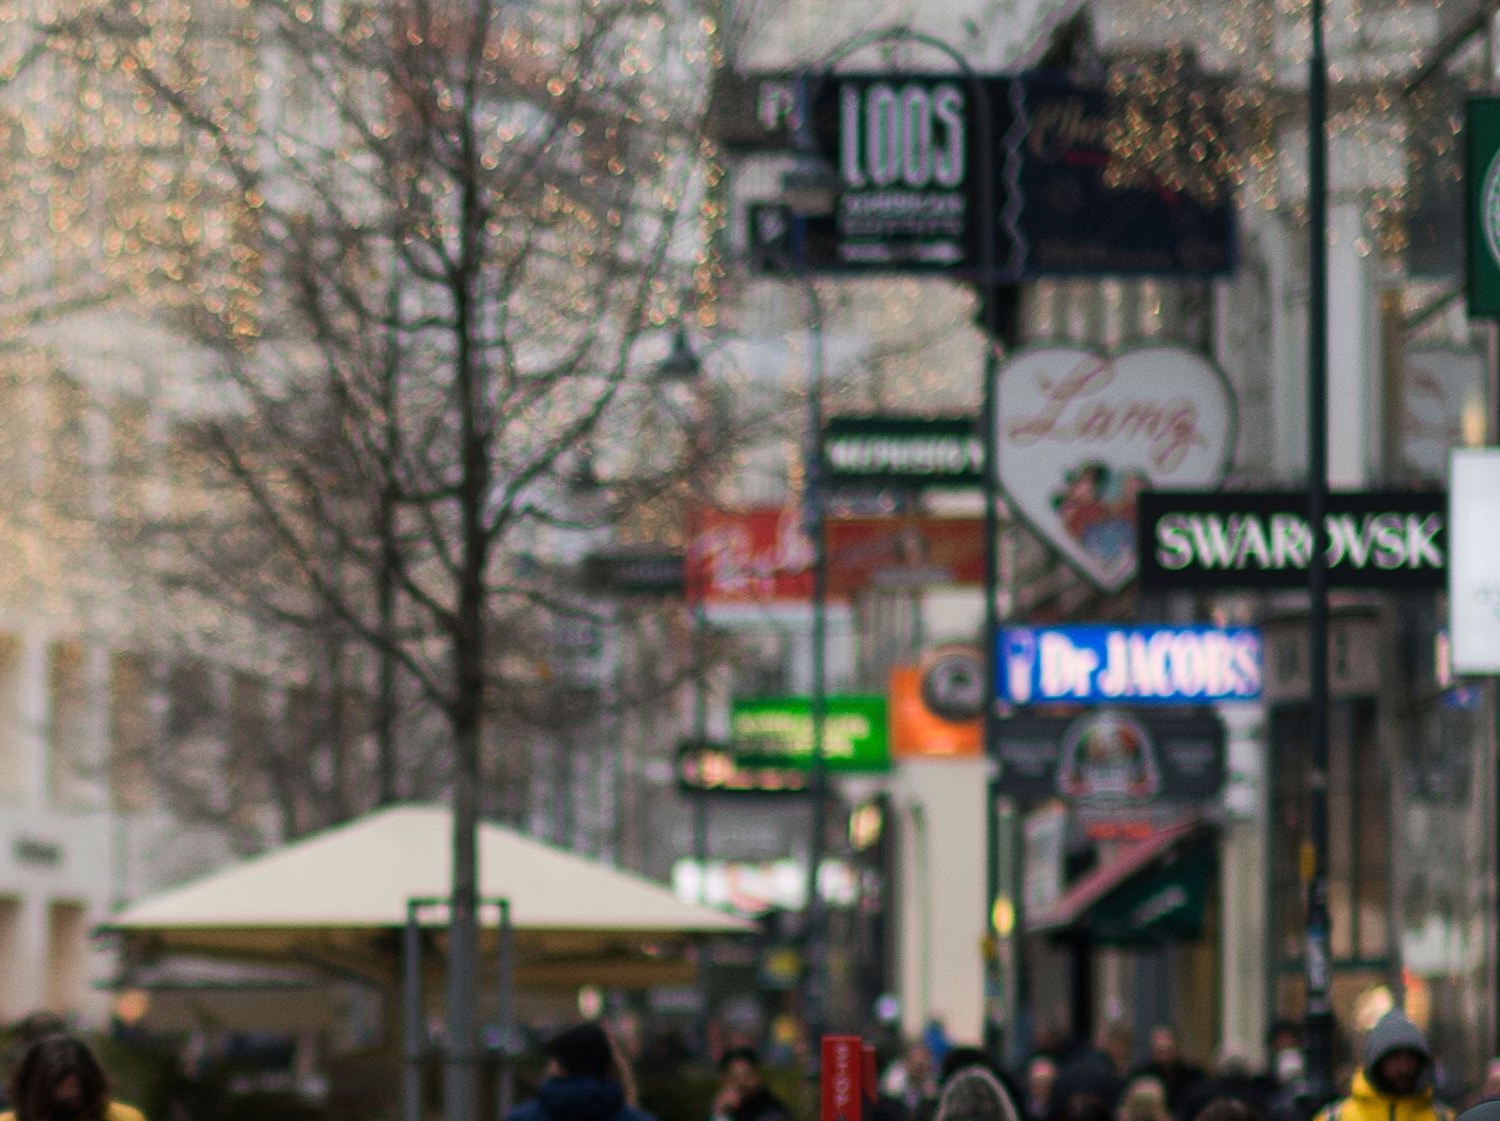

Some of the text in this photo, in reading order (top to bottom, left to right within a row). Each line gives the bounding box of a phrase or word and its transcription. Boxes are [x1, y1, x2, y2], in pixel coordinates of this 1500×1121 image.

[840, 83, 964, 187] LOOS
[1155, 512, 1444, 570] SWAROVSK
[1039, 631, 1098, 697] Dr
